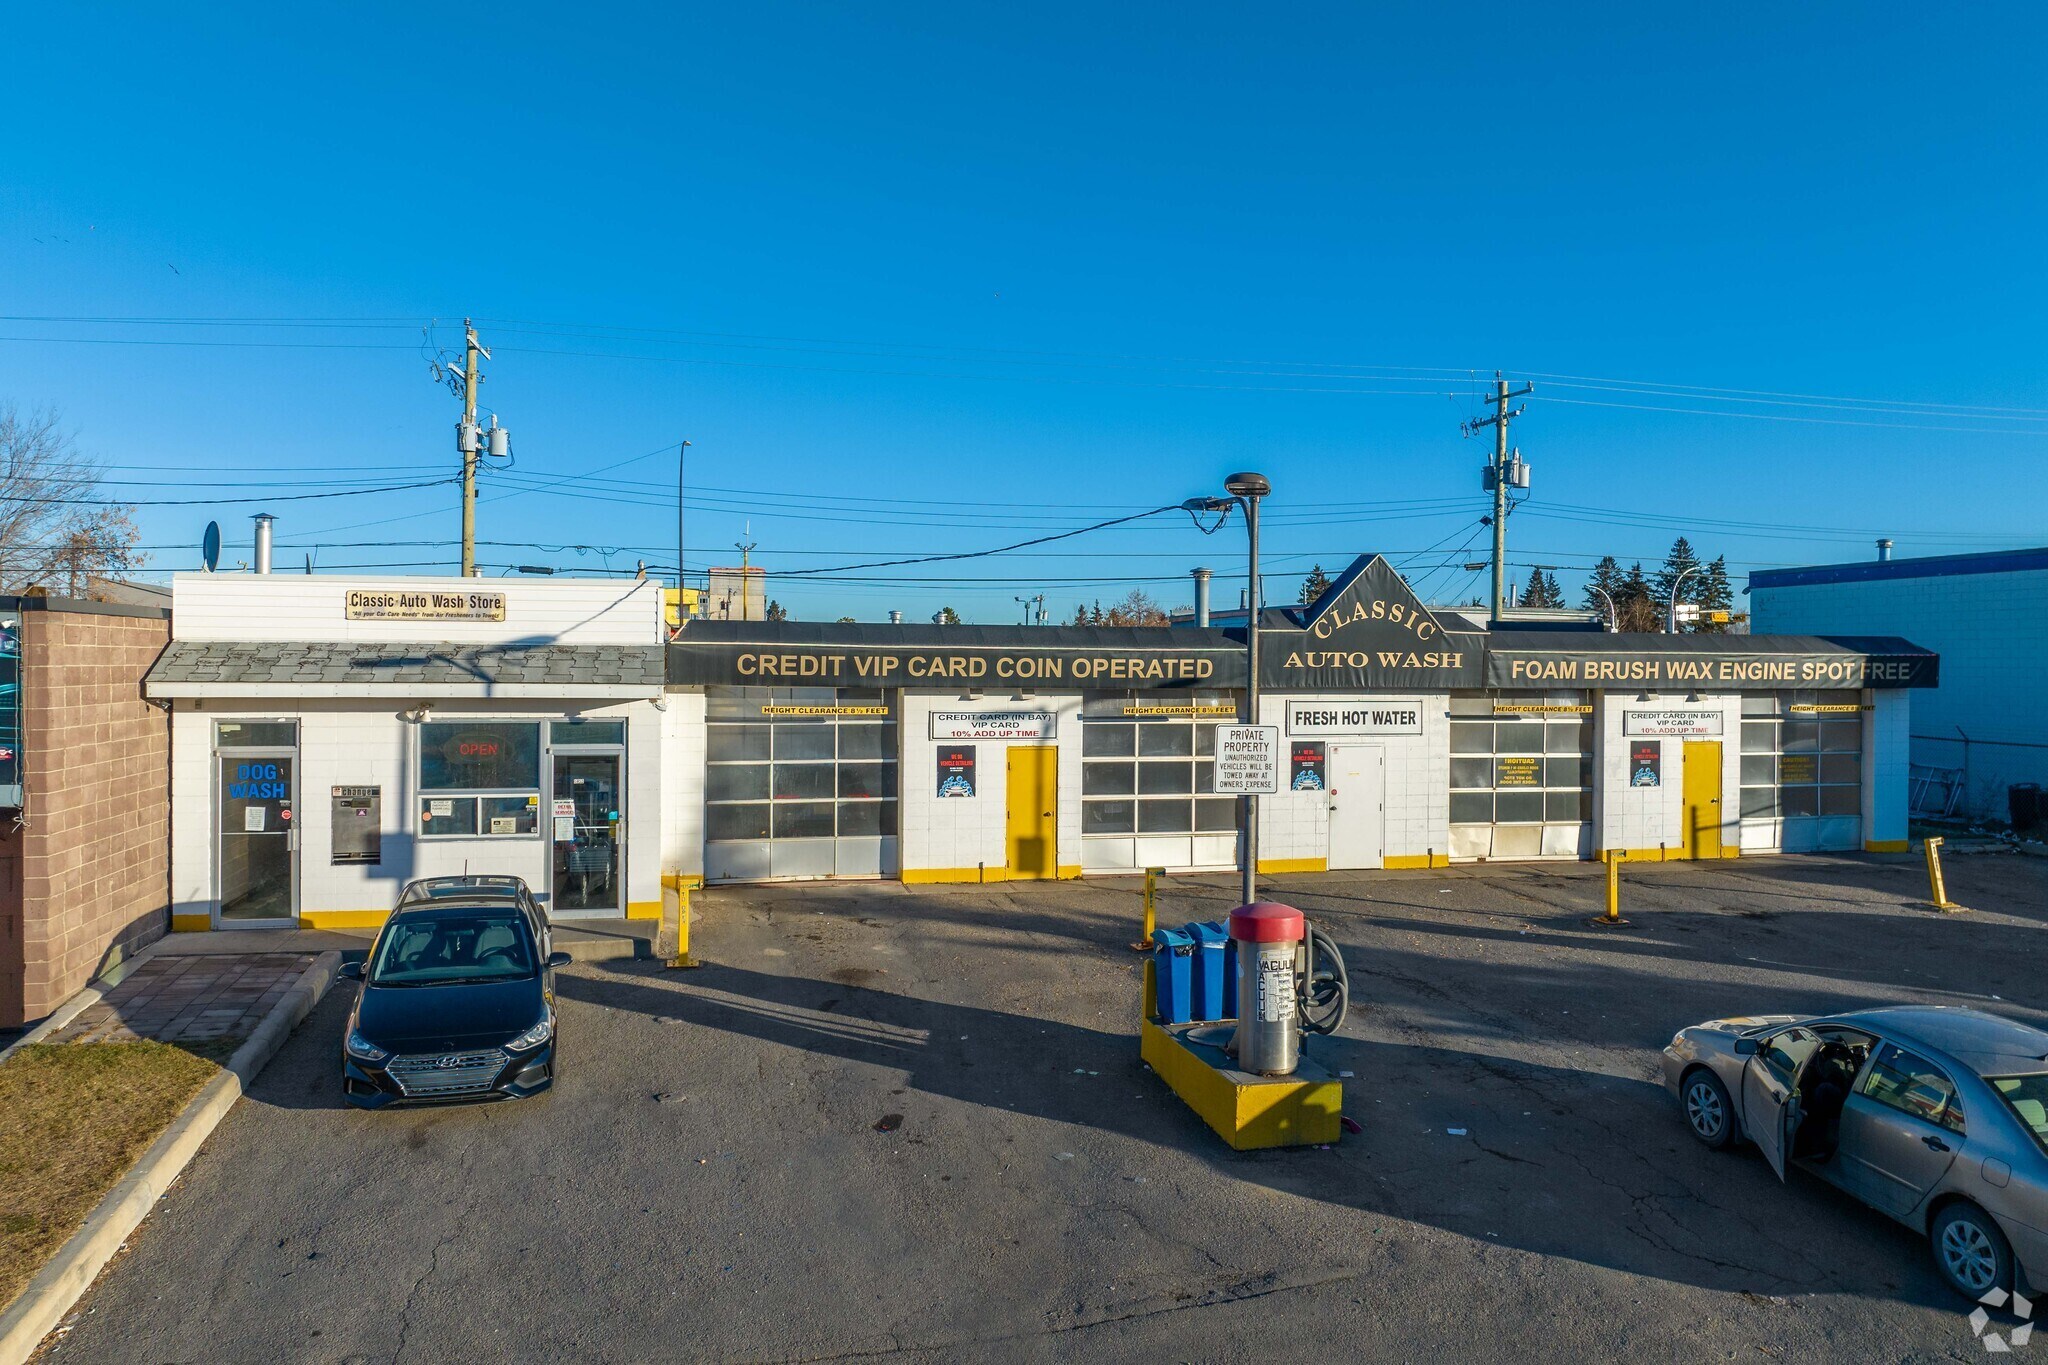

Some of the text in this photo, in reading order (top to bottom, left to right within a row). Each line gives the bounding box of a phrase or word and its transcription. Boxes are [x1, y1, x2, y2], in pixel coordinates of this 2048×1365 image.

[351, 593, 501, 608] Classic Auto Wash Store
[1314, 600, 1437, 640] CLASSIC
[737, 654, 1214, 679] CREDIT VIP CARD COIN OPERATED
[1283, 652, 1464, 668] AUTO WASH
[1512, 660, 1910, 680] FOAM BRUSH WAX ENGINE SPOT FREE
[1296, 711, 1416, 725] FRESH HOT WATER
[1230, 731, 1264, 740] PRIVATE
[460, 743, 499, 755] OPEN
[1224, 742, 1269, 752] PROPERTY
[238, 764, 277, 780] DOG
[229, 783, 285, 799] WASH
[343, 788, 371, 797] change
